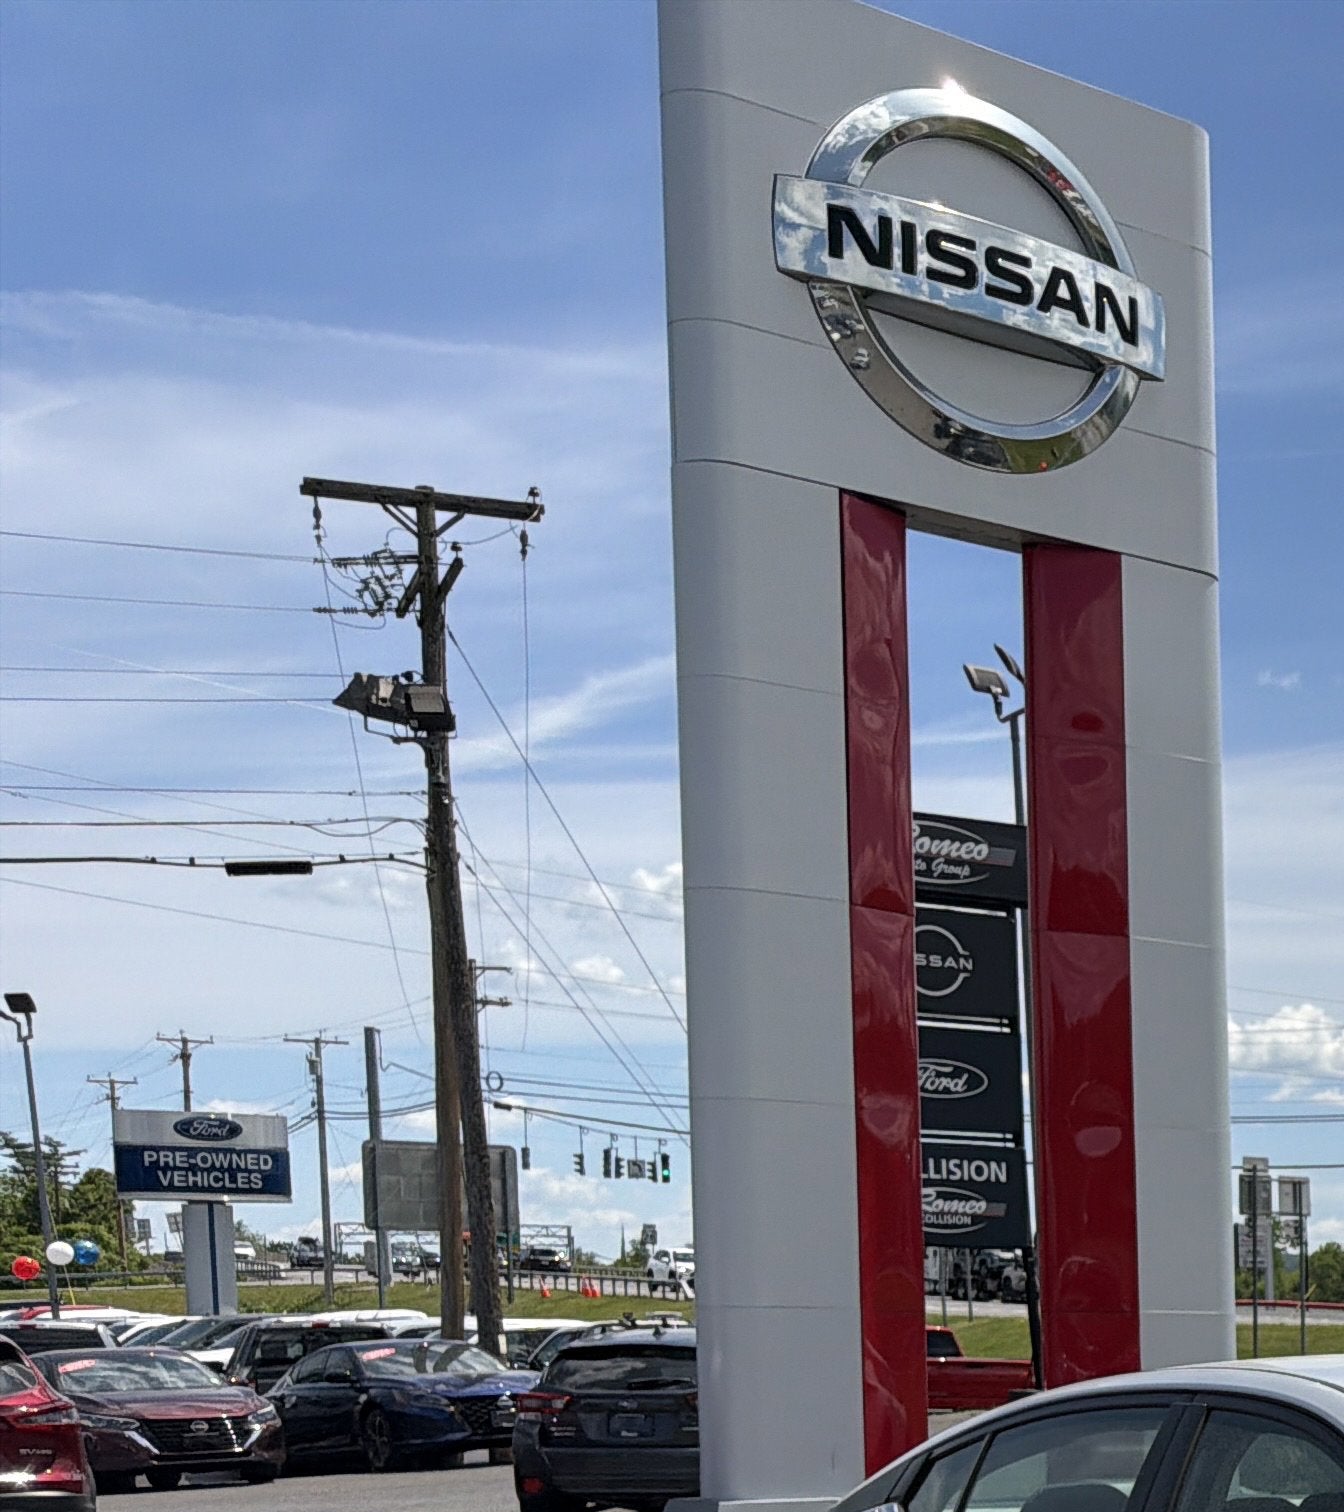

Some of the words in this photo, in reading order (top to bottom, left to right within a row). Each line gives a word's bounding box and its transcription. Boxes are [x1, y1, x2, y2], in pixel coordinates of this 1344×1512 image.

[826, 203, 1139, 348] NISSAN
[913, 823, 989, 861] omeo
[915, 953, 973, 971] SSAN
[190, 1120, 229, 1137] Ford
[143, 1150, 273, 1171] PRE-OWNED
[157, 1169, 263, 1189] VEHICLES
